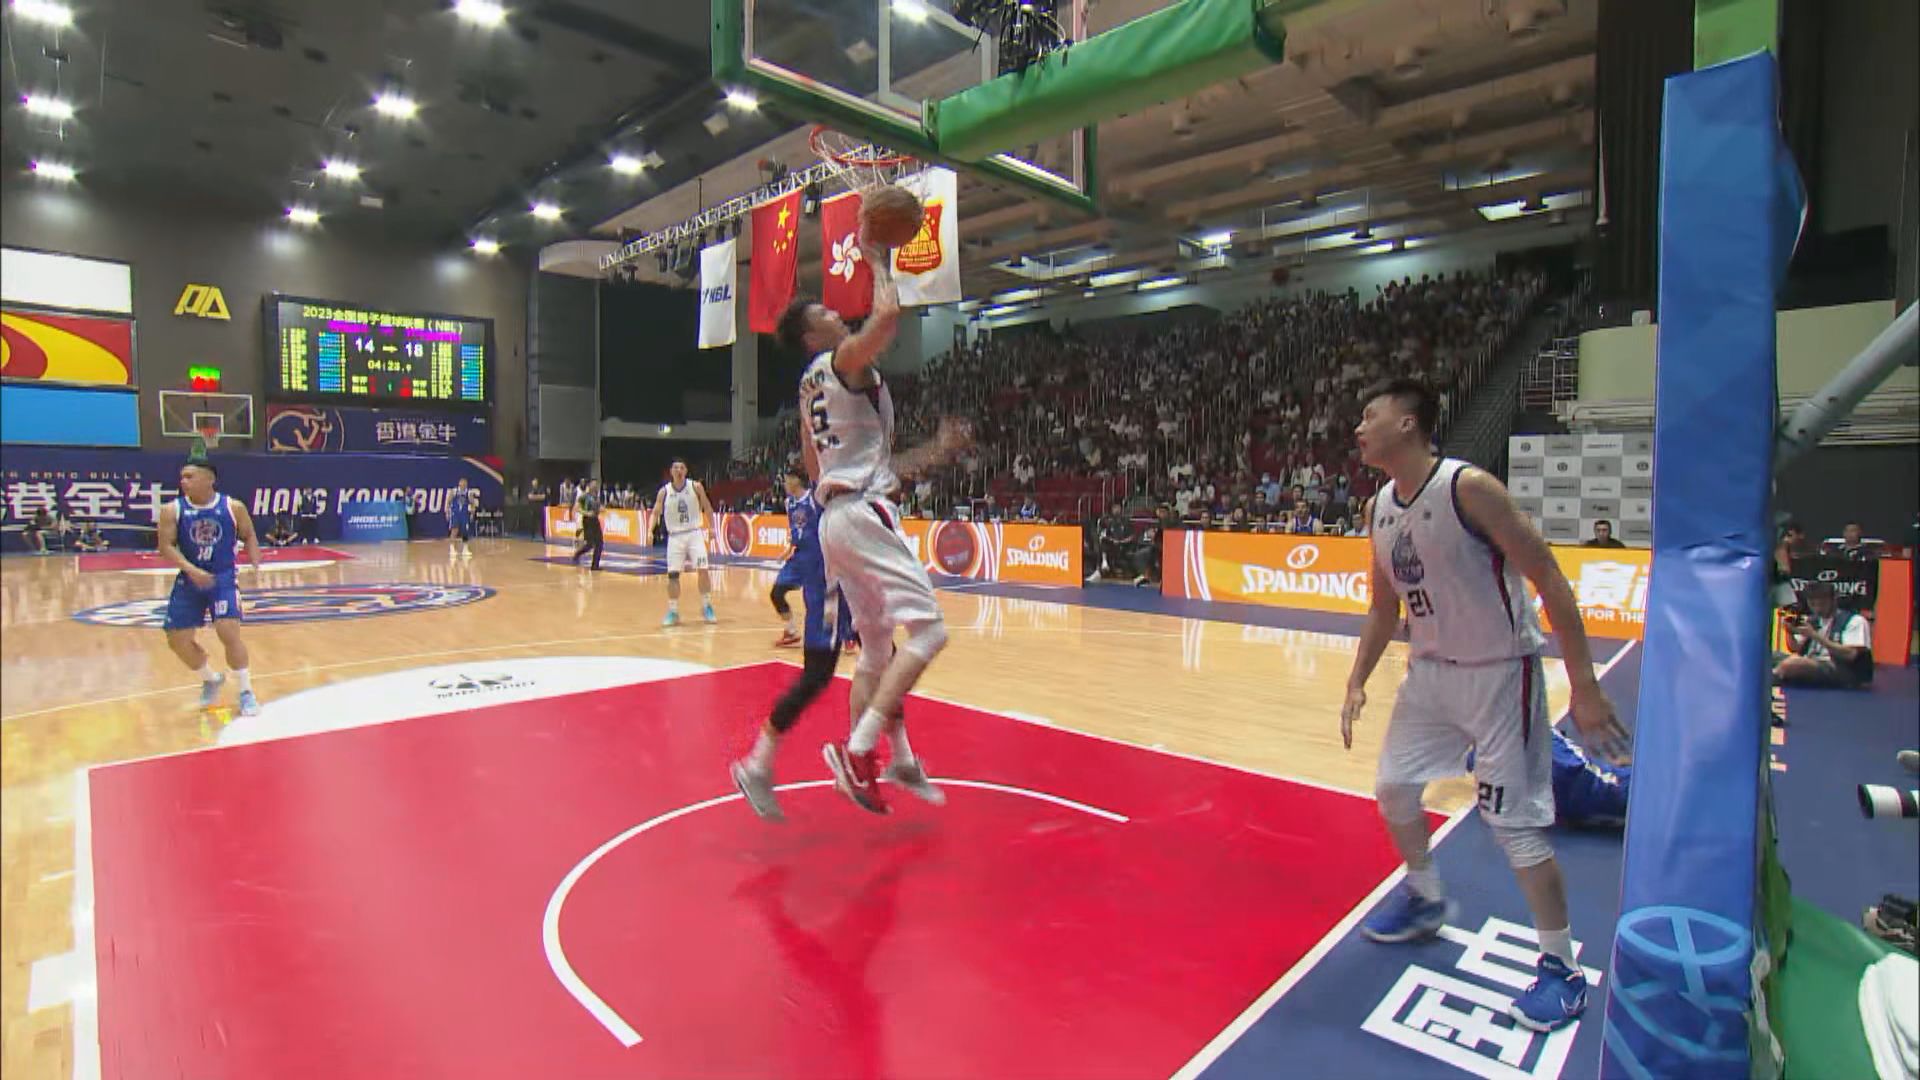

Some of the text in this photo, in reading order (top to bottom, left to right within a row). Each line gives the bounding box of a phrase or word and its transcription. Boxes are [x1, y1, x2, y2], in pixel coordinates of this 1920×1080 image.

[355, 338, 423, 358] 14 18
[375, 419, 457, 443] 香港金牛
[1006, 547, 1069, 572] SPALDING
[1242, 564, 1368, 603] SPALDING
[1407, 588, 1435, 617] 21
[1478, 782, 1505, 815] 21
